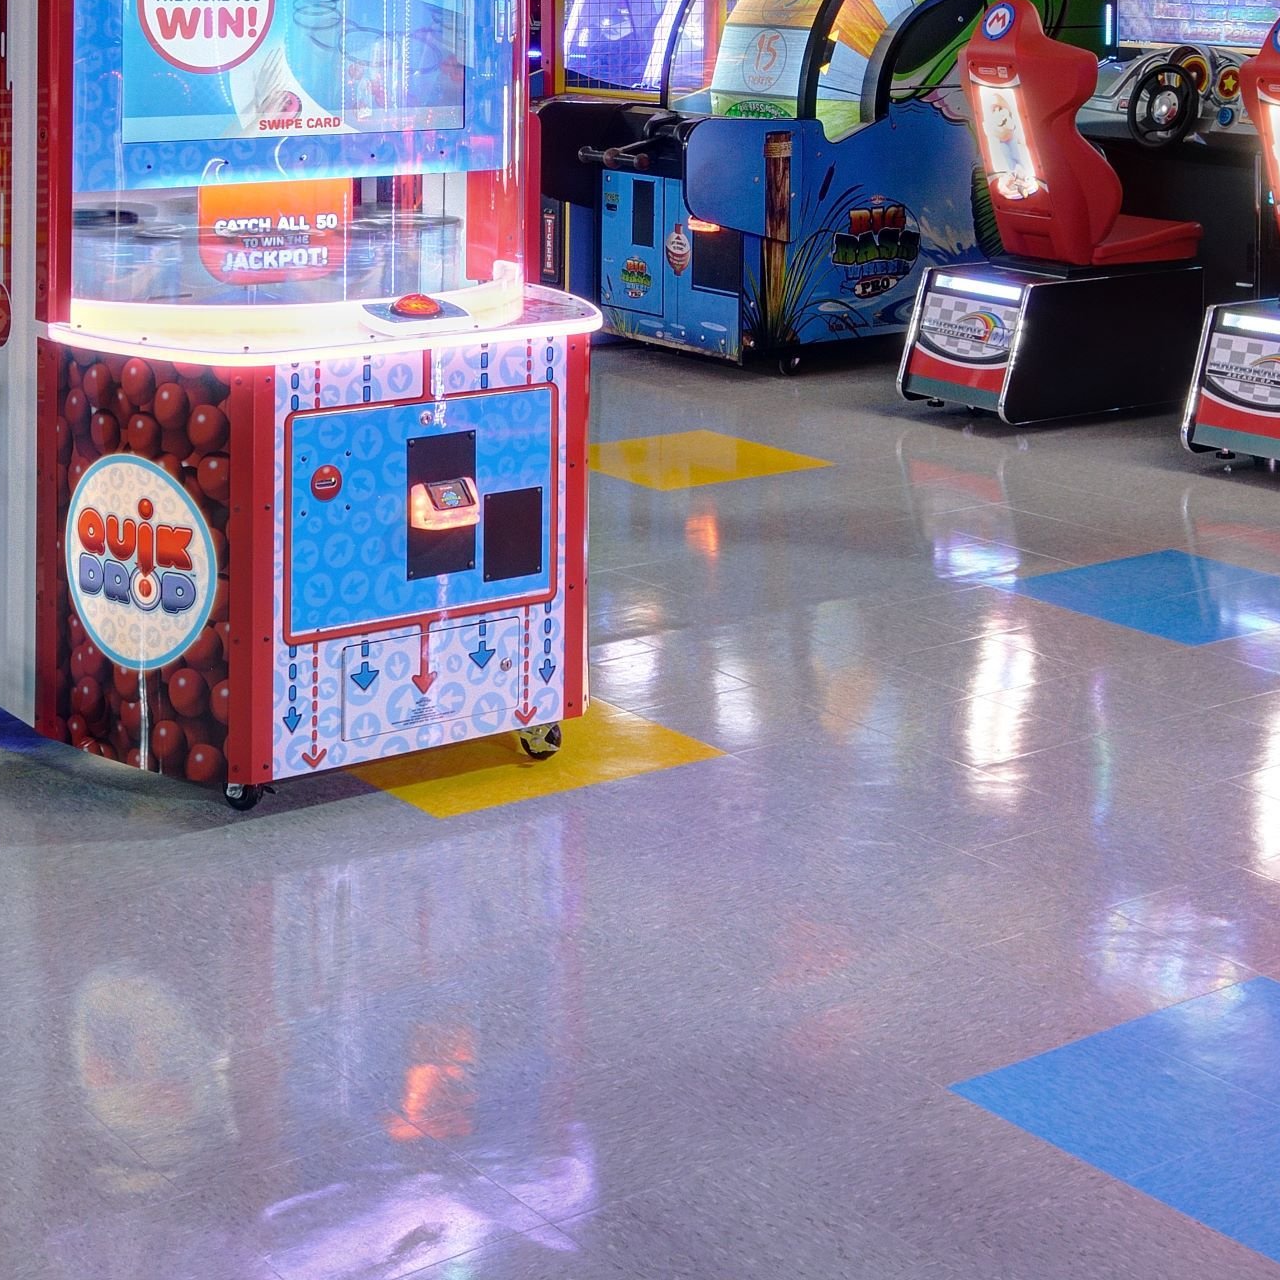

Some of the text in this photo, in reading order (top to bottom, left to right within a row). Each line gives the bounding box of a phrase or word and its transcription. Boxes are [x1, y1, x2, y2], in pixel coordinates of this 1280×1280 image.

[156, 6, 257, 40] WIN!
[755, 33, 781, 71] 15
[259, 116, 341, 131] SWIPE CARD
[215, 214, 338, 236] CATCH ALL 50
[848, 204, 906, 236] BIG
[243, 234, 309, 249] TO WIN THE
[545, 218, 553, 269] TICKETS
[832, 227, 921, 266] BASS
[222, 247, 328, 272] JACKPOT!
[860, 276, 891, 294] PRO
[987, 325, 1016, 350] DX
[79, 552, 197, 613] DROP
